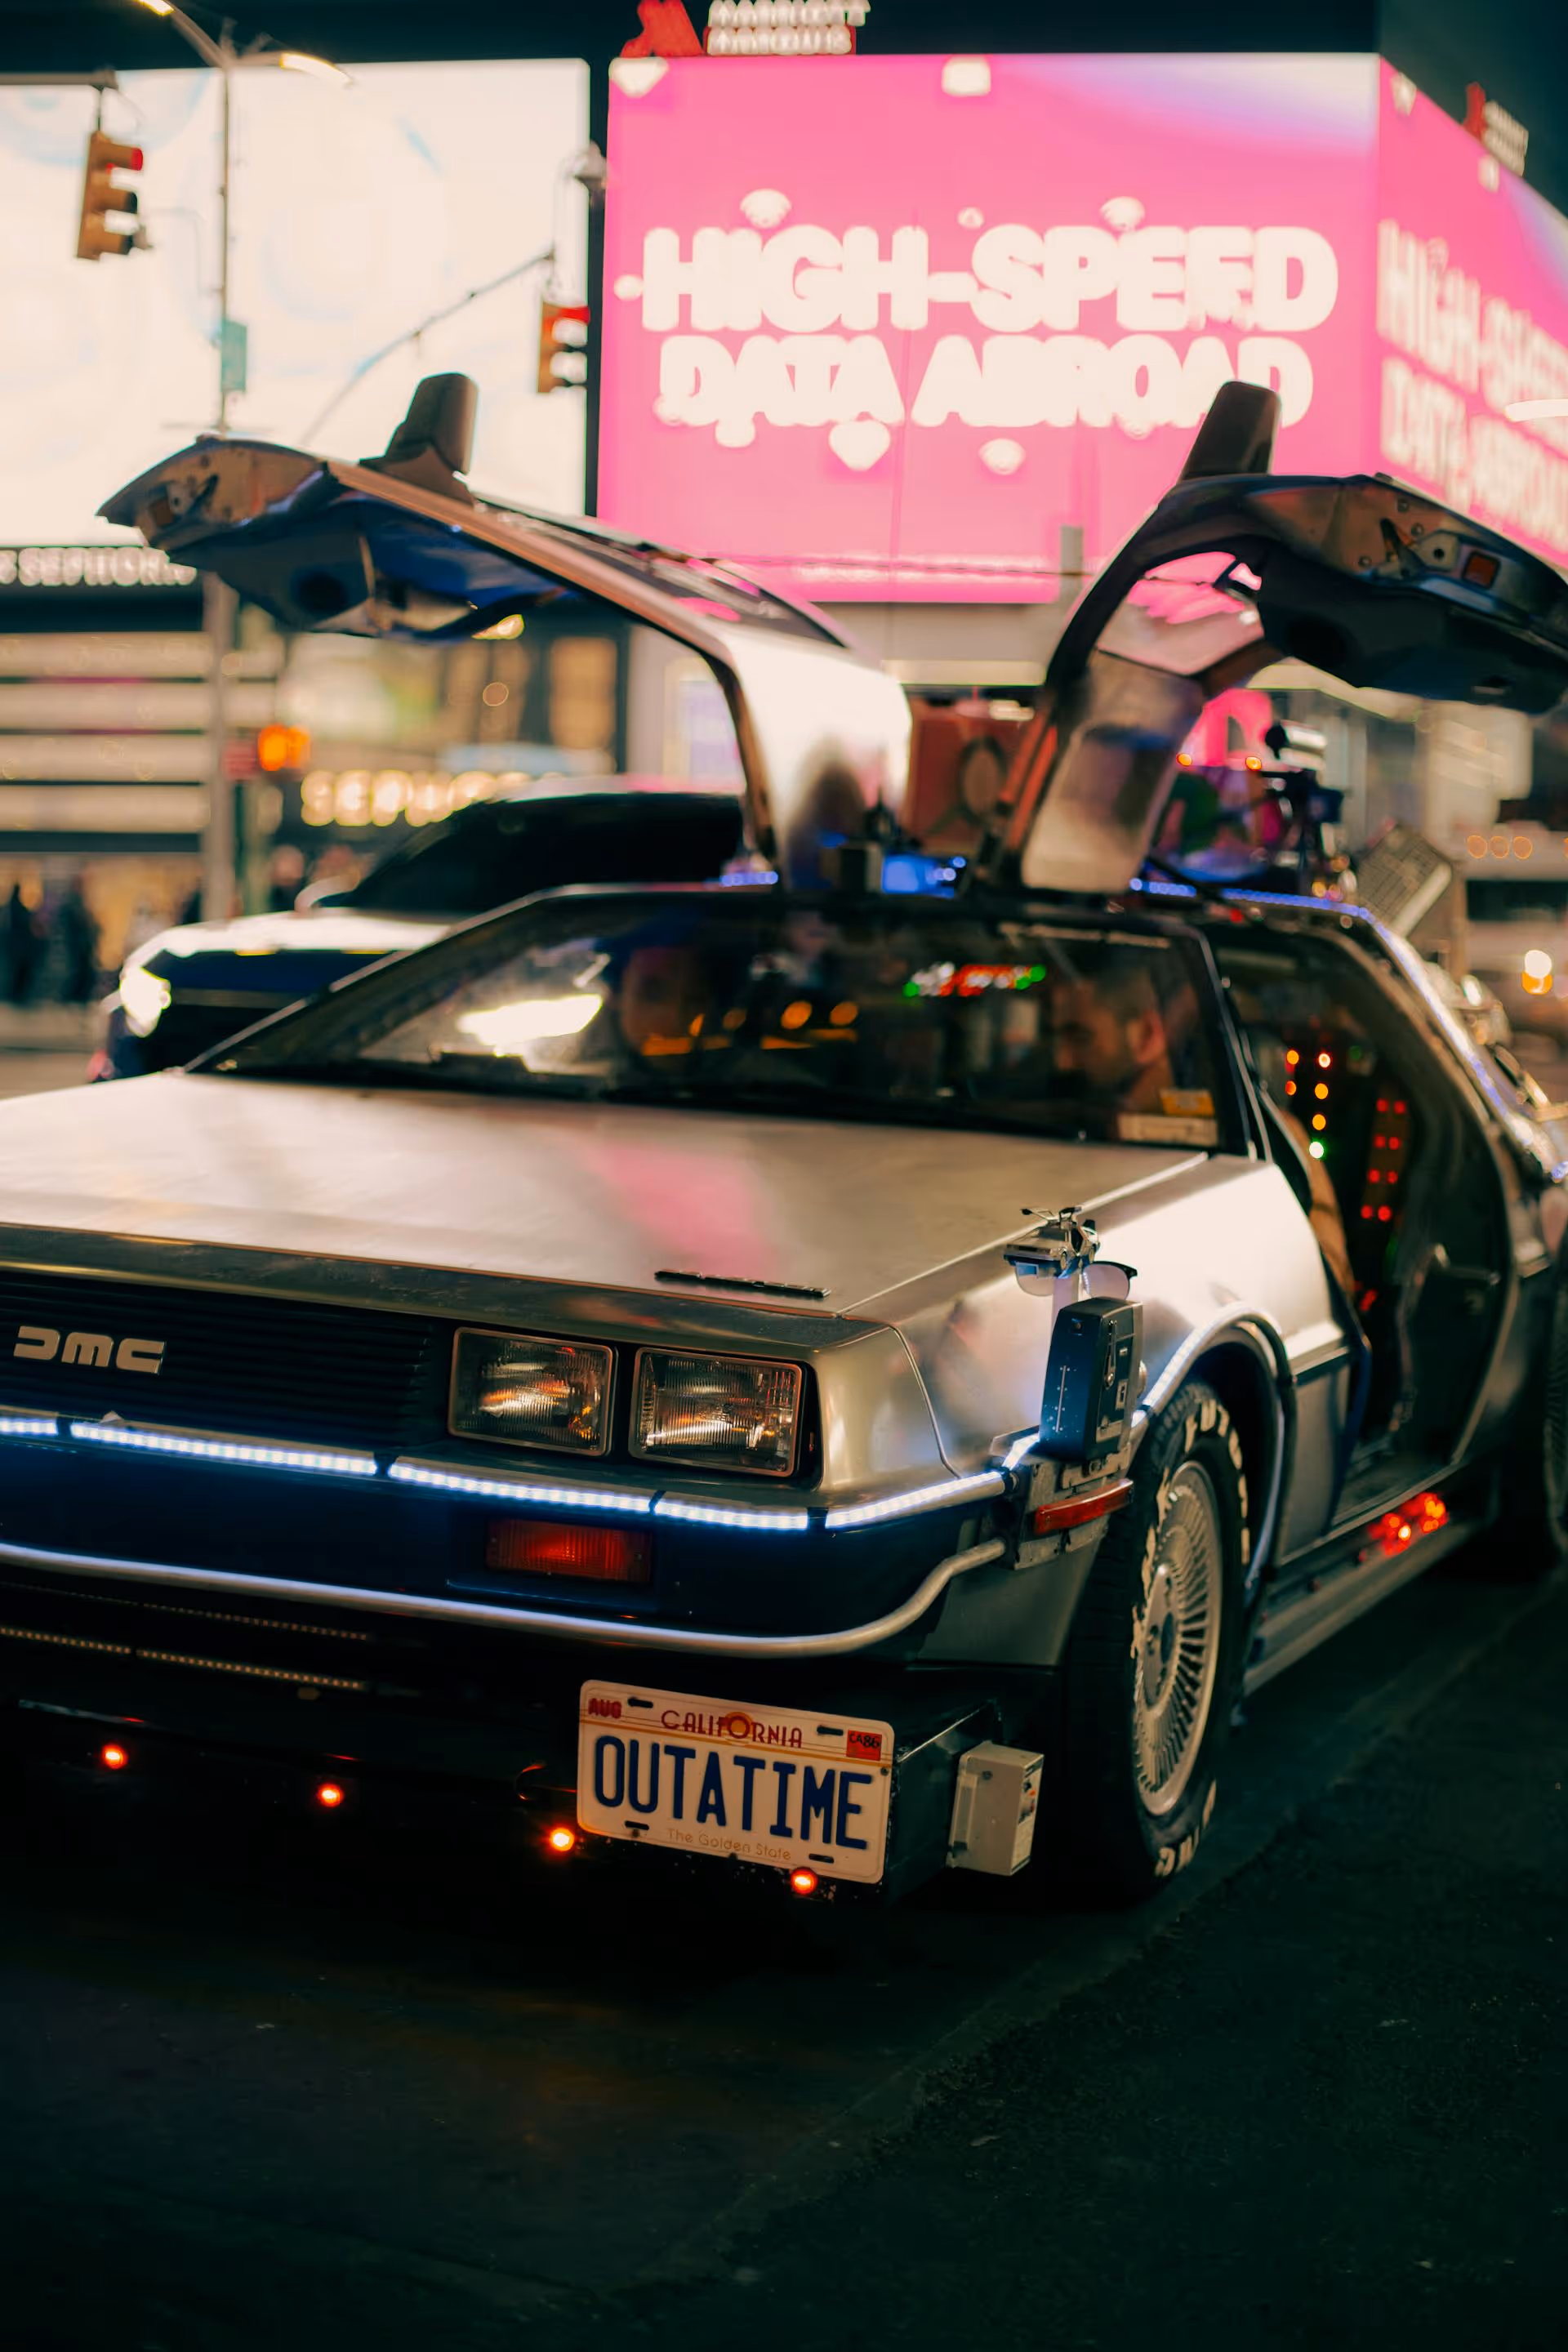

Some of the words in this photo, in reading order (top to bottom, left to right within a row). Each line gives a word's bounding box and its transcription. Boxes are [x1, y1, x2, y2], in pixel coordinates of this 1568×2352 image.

[642, 224, 1338, 332] HIGH-SPEED
[658, 335, 905, 427] DATA
[911, 335, 1313, 428] ABROAD
[14, 1325, 167, 1374] DMC
[588, 1697, 622, 1719] AUG
[661, 1709, 803, 1748] CALIFORNIA
[595, 1735, 873, 1850] OUTATIME
[666, 1827, 693, 1844] The
[698, 1833, 751, 1853] Golden
[756, 1842, 791, 1860] State
